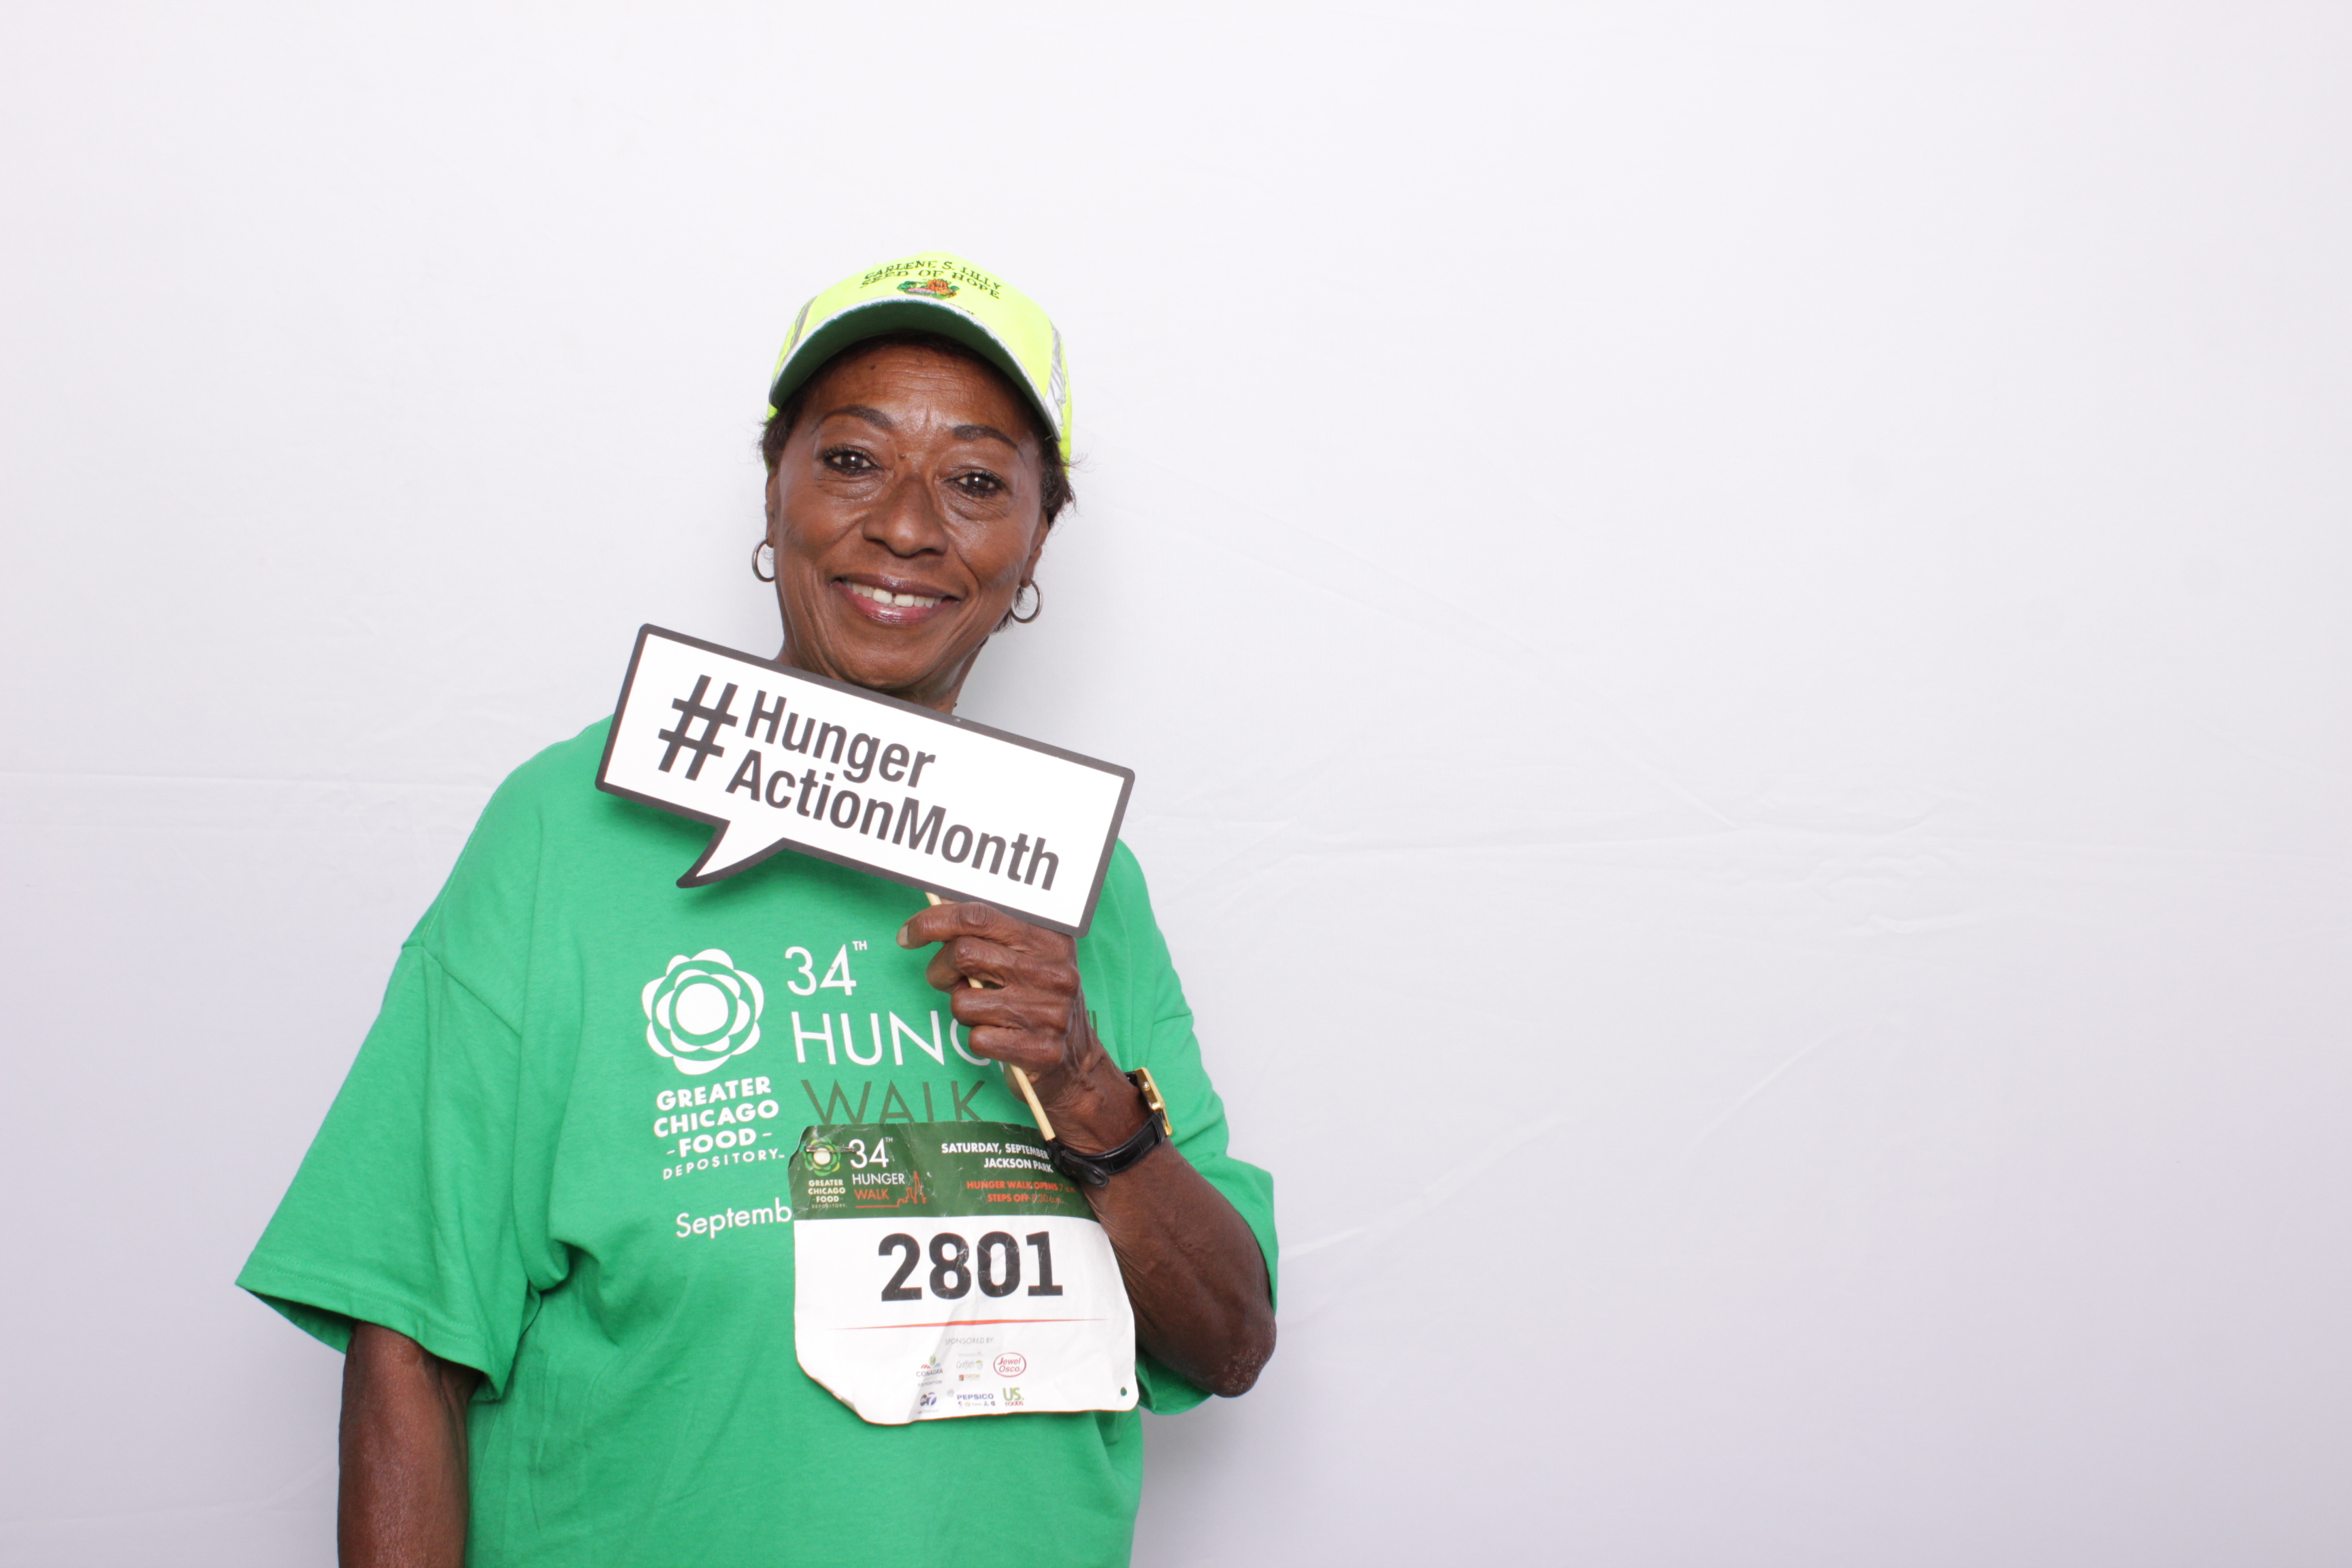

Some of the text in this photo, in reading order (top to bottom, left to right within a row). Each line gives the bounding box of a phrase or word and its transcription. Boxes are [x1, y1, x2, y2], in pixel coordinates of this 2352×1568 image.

[942, 261, 955, 270] S.
[960, 266, 1002, 290] LILLY
[860, 271, 909, 289] SEED
[952, 272, 1000, 299] HOPE
[725, 749, 1060, 891] ActionMonth
[791, 1010, 1004, 1072] HUN
[656, 1076, 771, 1111] GREATER
[801, 1079, 985, 1125] WALK
[653, 1100, 779, 1137] CHICAGO
[941, 1143, 1050, 1160] SATURDAY, SEPTEMBER
[663, 1148, 779, 1180] DEPOSITORY
[983, 1158, 1054, 1173] JACKSON PARK
[852, 1173, 905, 1185] HUNGER
[966, 1181, 1006, 1190] HUNGER
[1007, 1181, 1032, 1190] WALK
[1034, 1181, 1058, 1191] OPENS
[808, 1187, 846, 1195] CHICAGO
[853, 1189, 890, 1200] WALK
[987, 1194, 1011, 1203] STEPS
[1013, 1194, 1029, 1203] OFF
[676, 1197, 792, 1239] Septemb
[878, 1231, 1063, 1302] 2801
[945, 1337, 984, 1345] SPONSORED
[956, 1360, 975, 1370] Griffith
[998, 1357, 1021, 1365] Jewel
[916, 1368, 943, 1377] CONAGRA
